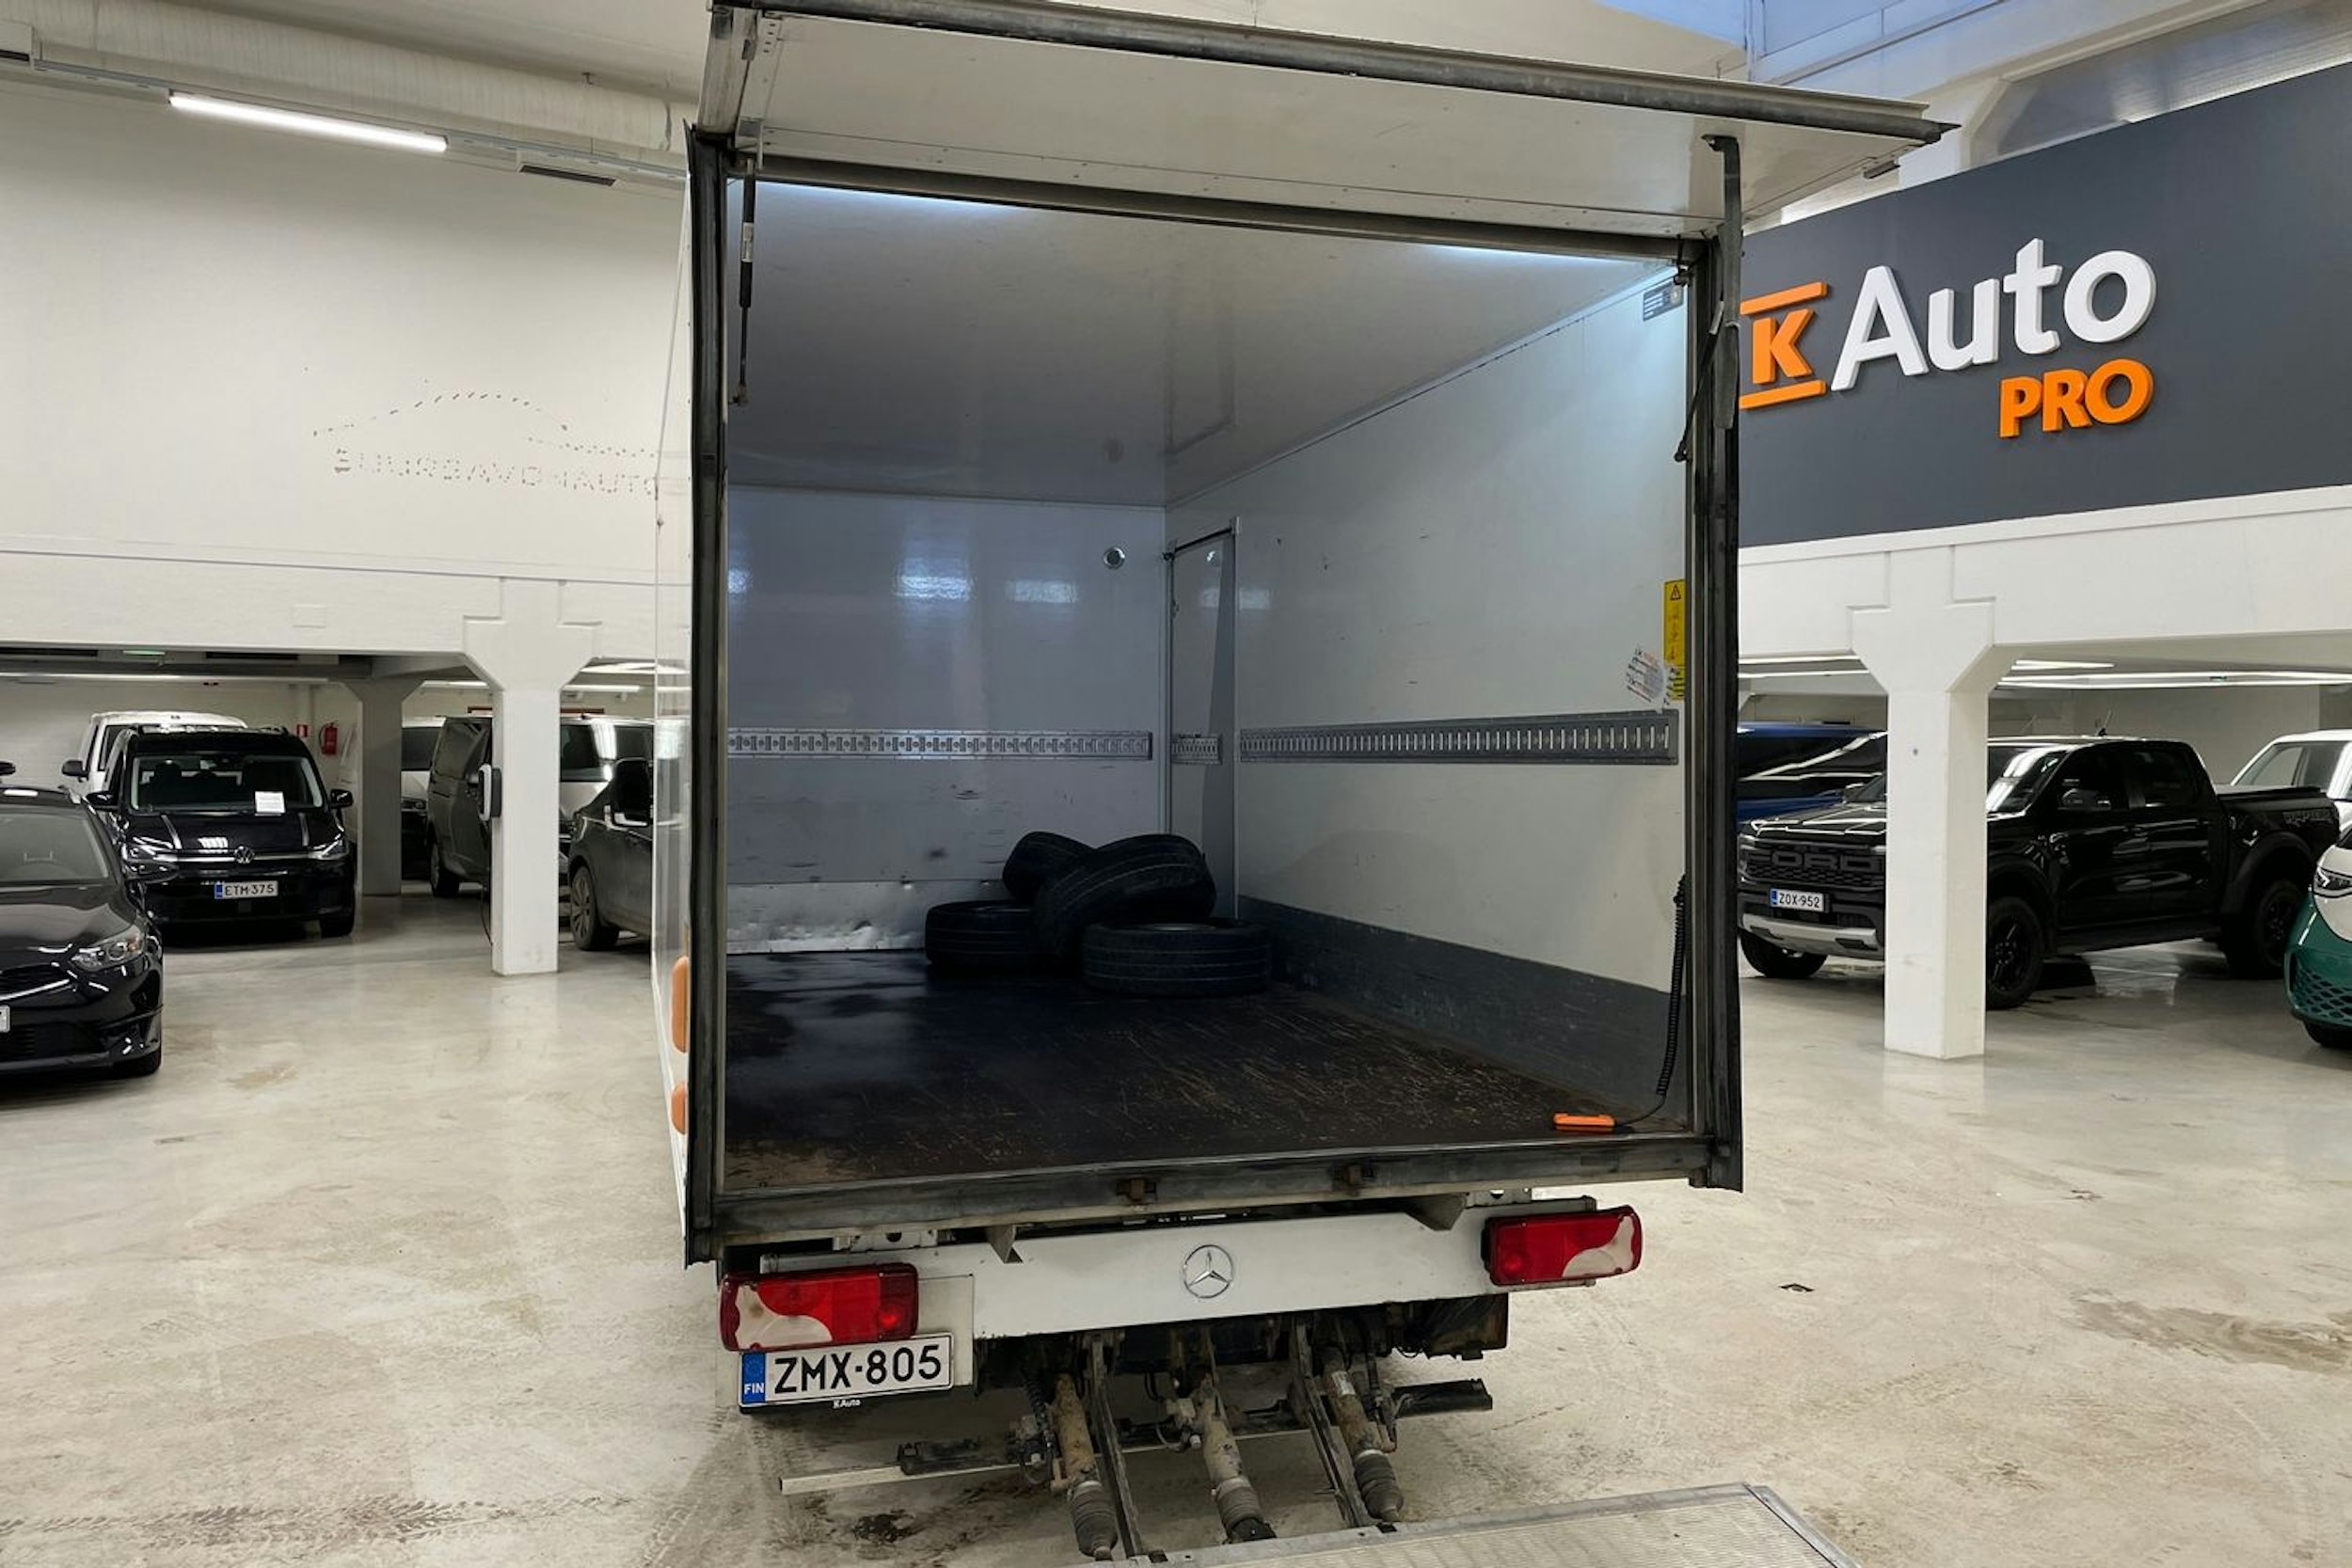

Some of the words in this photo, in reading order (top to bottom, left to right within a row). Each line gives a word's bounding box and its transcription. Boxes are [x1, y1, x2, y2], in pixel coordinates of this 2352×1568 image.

[1752, 307, 1816, 385] K
[1830, 237, 2157, 391] Auto
[1999, 358, 2154, 438] PRO
[744, 1383, 765, 1395] FIN
[774, 1344, 941, 1394] ZMX-805
